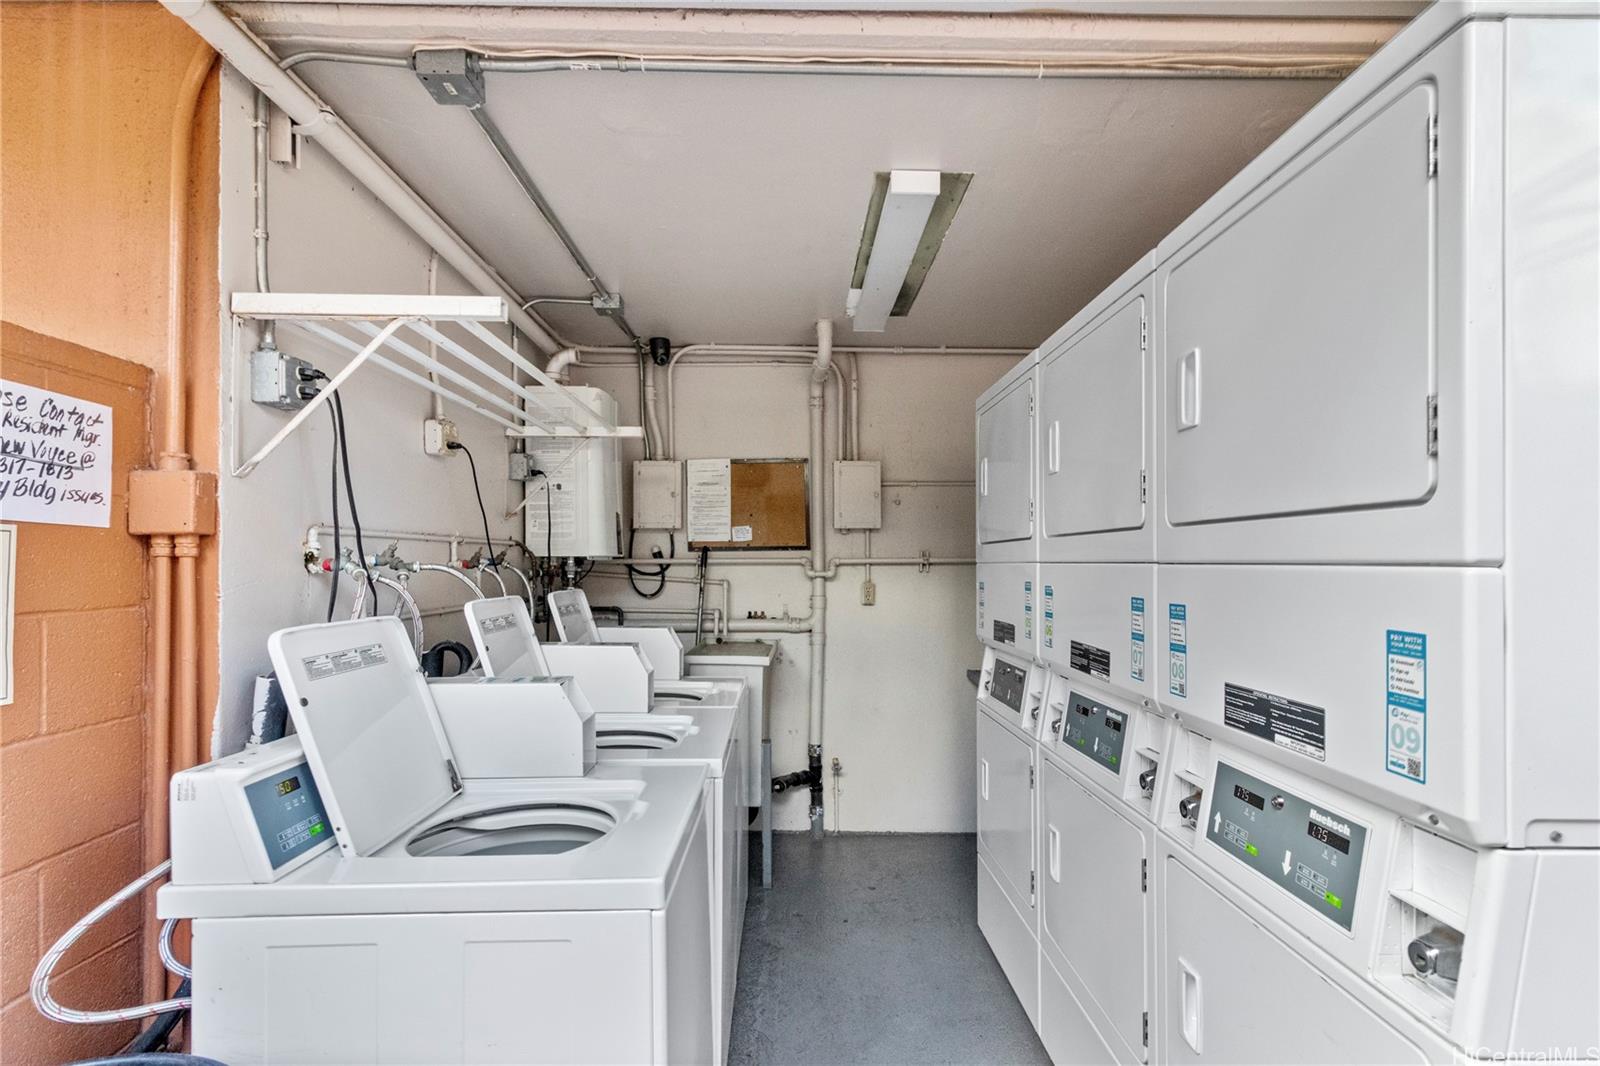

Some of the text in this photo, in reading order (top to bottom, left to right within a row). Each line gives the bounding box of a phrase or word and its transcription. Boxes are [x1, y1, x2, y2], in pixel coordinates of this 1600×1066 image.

[2, 411, 68, 439] Resident
[40, 398, 103, 426] Contact
[80, 451, 96, 469] @
[13, 477, 57, 505] Bldg
[1171, 662, 1185, 680] 08
[1391, 723, 1420, 754] 09
[1309, 808, 1351, 836] Huebsch
